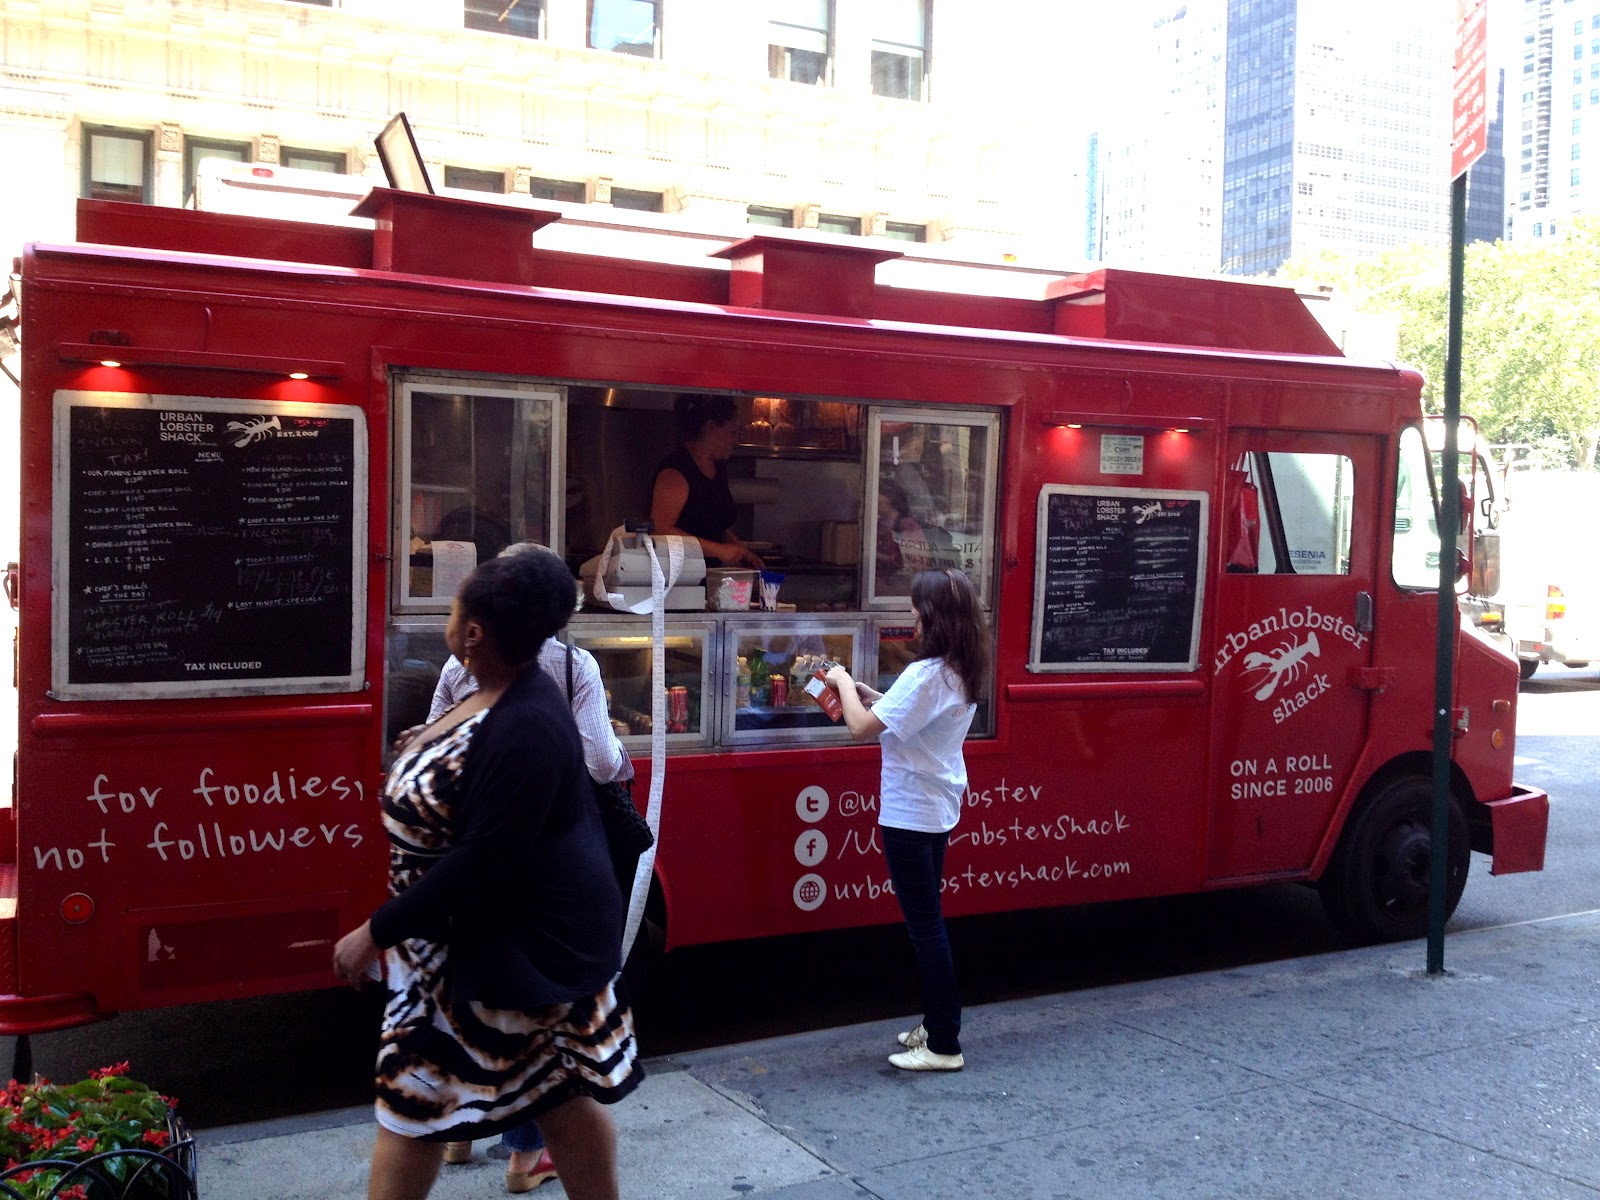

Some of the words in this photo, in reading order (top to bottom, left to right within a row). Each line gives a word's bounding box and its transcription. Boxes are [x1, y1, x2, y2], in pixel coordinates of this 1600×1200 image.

[160, 412, 203, 421] URBAN
[160, 422, 214, 432] LOBSTER
[160, 432, 202, 442] SHACK
[198, 451, 222, 459] MENU
[133, 468, 166, 477] LOBSTER
[1097, 507, 1127, 515] LOBSTER
[1117, 647, 1149, 655] INCLUDED
[184, 662, 206, 671] TAX
[208, 661, 263, 670] INCLUDED
[1272, 673, 1332, 725] shack
[1230, 758, 1257, 777] ON
[1265, 758, 1278, 775] A
[1286, 754, 1333, 772] ROLL
[86, 773, 163, 814] for
[192, 767, 364, 807] foodies,
[1230, 779, 1287, 800] SINCE
[1294, 776, 1334, 795] 2006
[33, 827, 116, 872] not
[146, 821, 364, 862] followers
